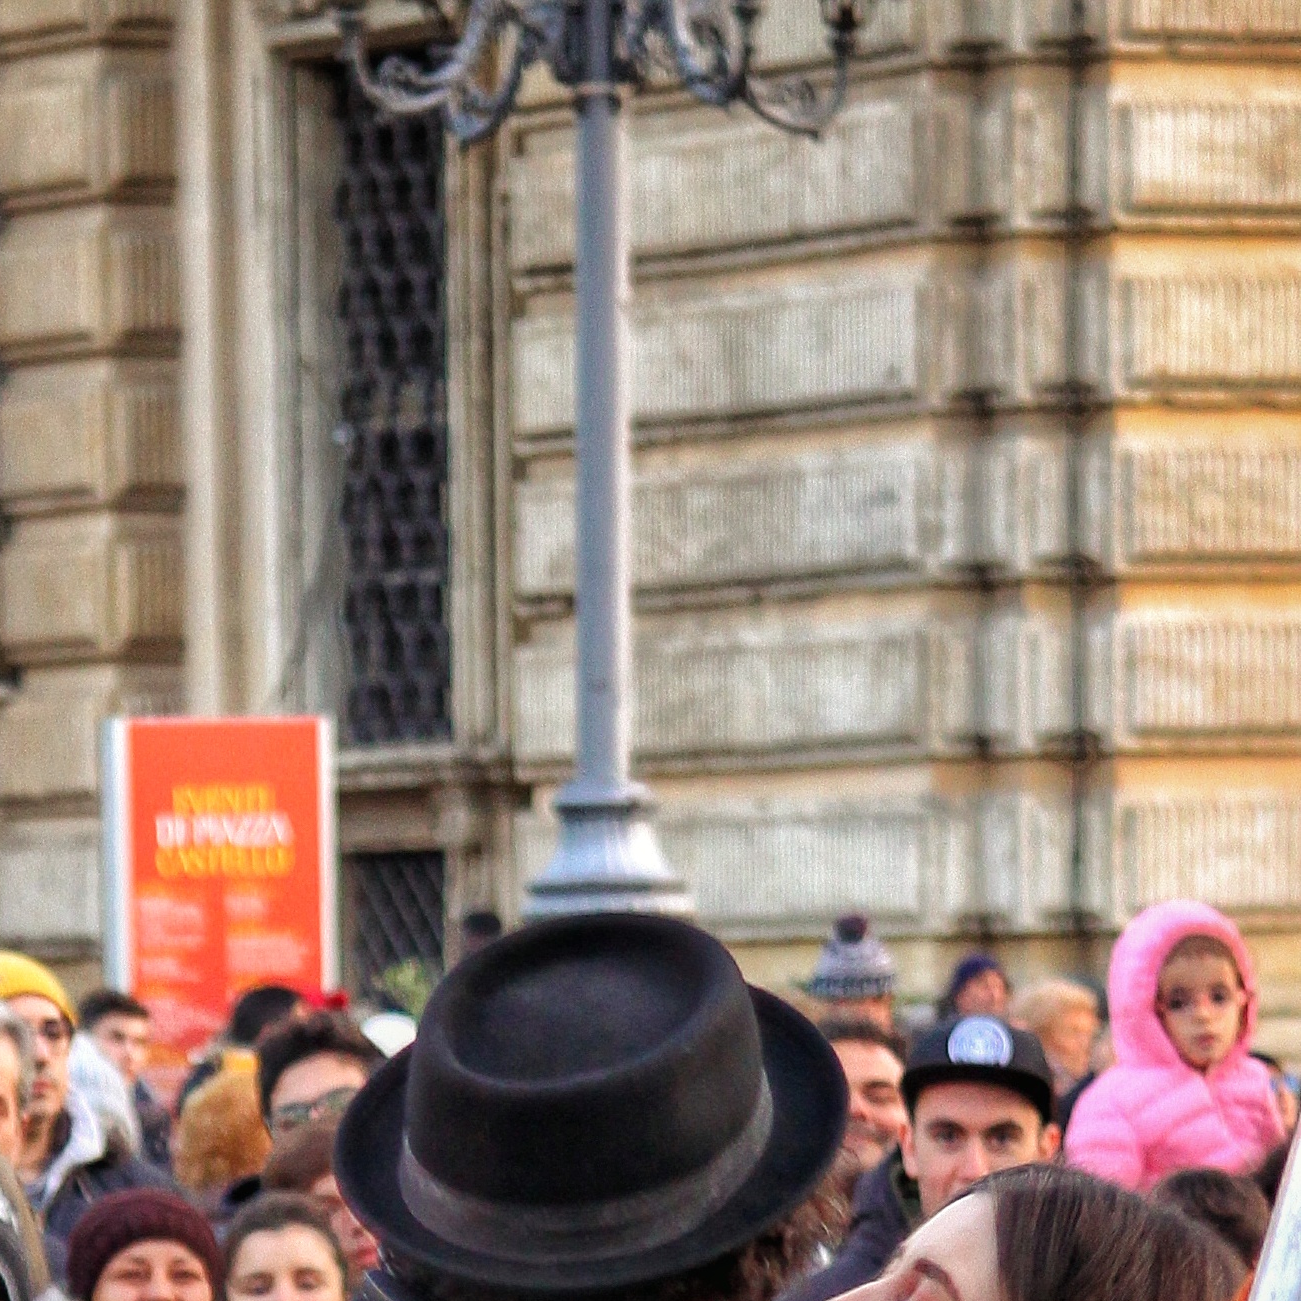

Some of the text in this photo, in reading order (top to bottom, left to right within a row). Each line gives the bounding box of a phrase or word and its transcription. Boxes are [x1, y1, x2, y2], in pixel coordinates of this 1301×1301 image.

[154, 815, 296, 848] DI PIAZZA
[154, 847, 296, 879] CASTELLO
